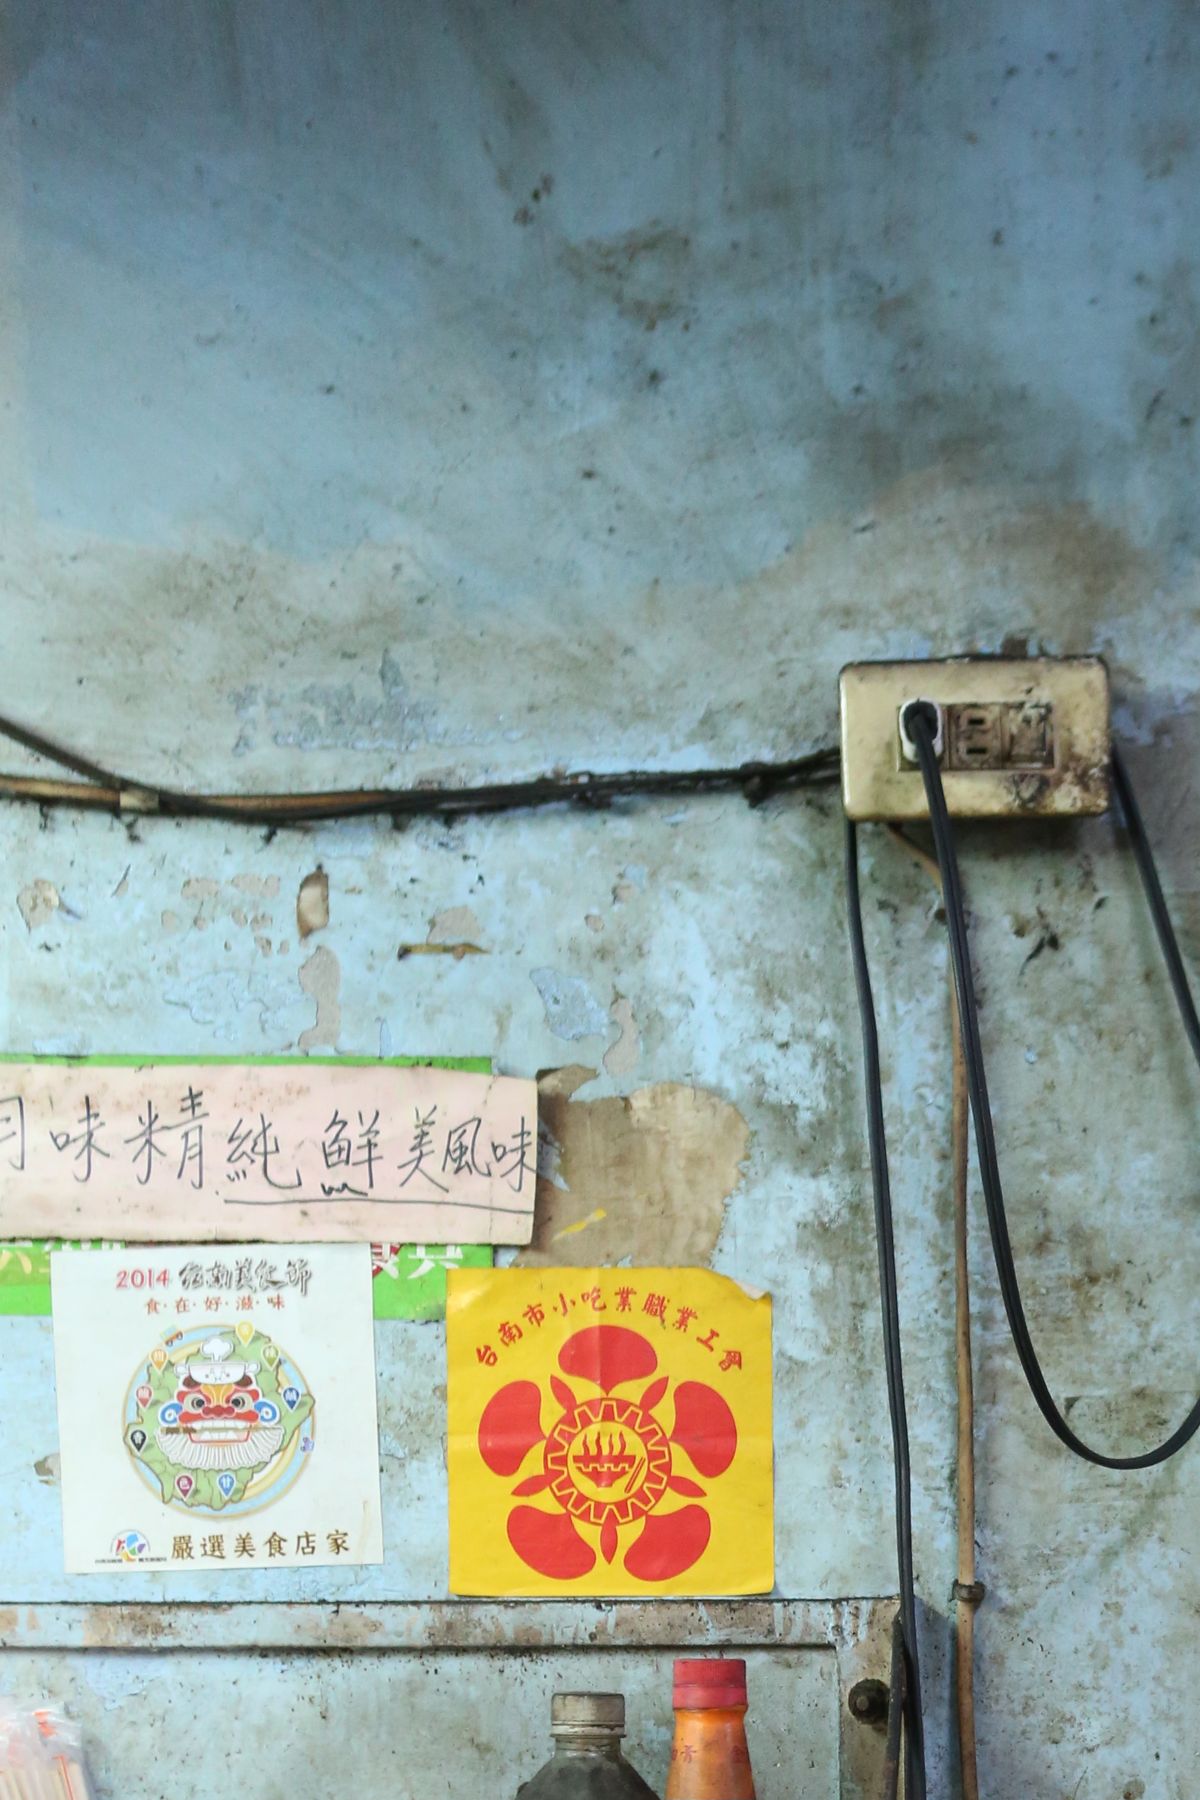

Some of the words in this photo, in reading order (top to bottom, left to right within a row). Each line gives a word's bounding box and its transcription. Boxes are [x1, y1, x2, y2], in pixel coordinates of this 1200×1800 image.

[116, 1268, 170, 1290] 2014
[170, 1528, 351, 1562] 嚴選美食店家
